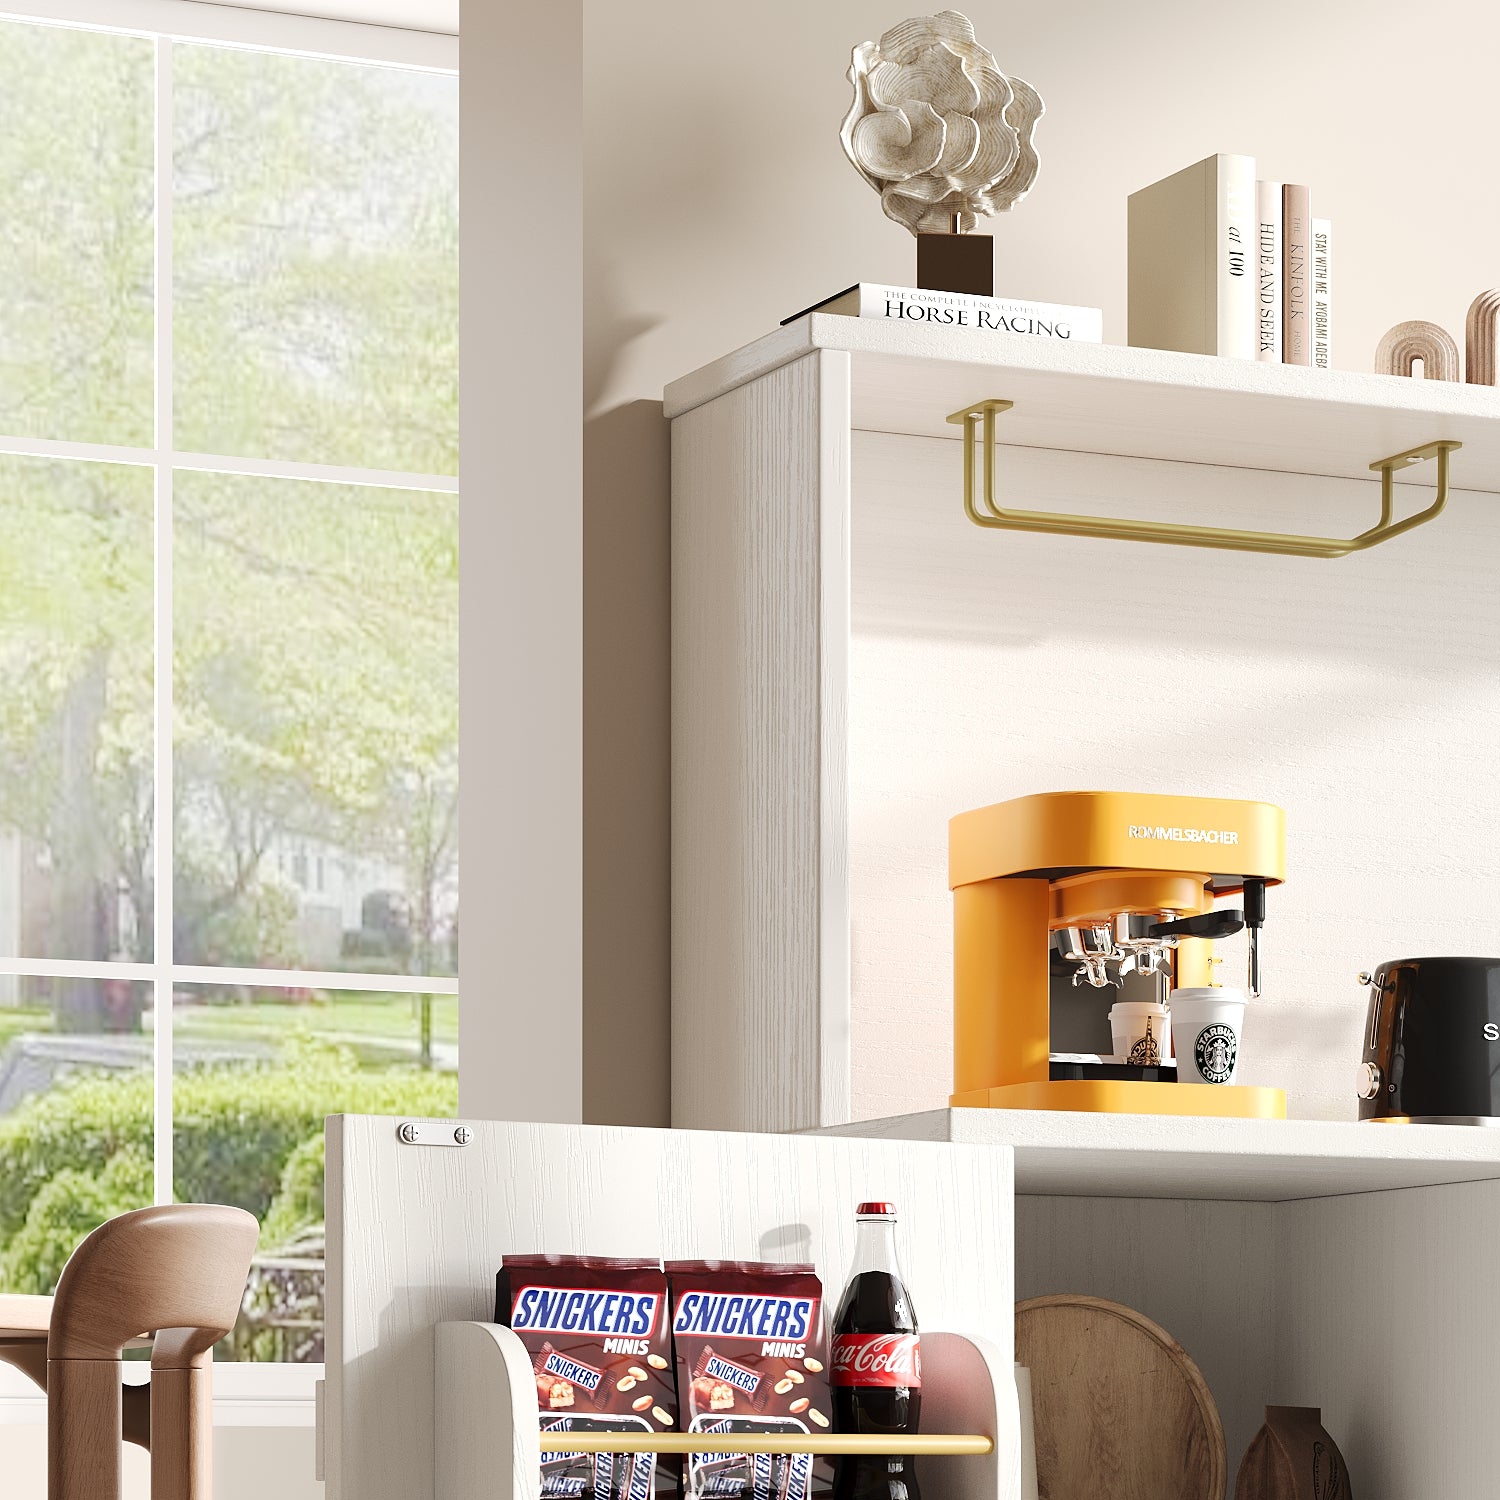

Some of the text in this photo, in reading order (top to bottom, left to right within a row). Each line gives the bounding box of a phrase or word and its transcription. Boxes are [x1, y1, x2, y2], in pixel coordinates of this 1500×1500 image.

[1229, 227, 1241, 243] at
[1315, 233, 1327, 254] STAY
[1229, 251, 1244, 276] 100
[1315, 257, 1327, 279] WITH
[1260, 223, 1274, 353] HIDE AND SEEK
[1291, 243, 1304, 320] KINFOLK
[1315, 281, 1327, 294] ME
[884, 291, 906, 300] THE
[911, 293, 968, 307] COMPLETE
[885, 300, 1071, 339] HORSE RACING
[1315, 302, 1327, 339] AYOBAMI
[1128, 825, 1239, 845] ROMMELSBACHER
[1197, 1026, 1237, 1053] STARBUCKS
[513, 1289, 654, 1334] SNICKERS
[676, 1295, 810, 1338] SNICKERS
[603, 1338, 650, 1355] MINIS
[761, 1341, 806, 1359] MINIS
[547, 1355, 600, 1389] SNICKERS
[708, 1358, 758, 1391] SNICKERS
